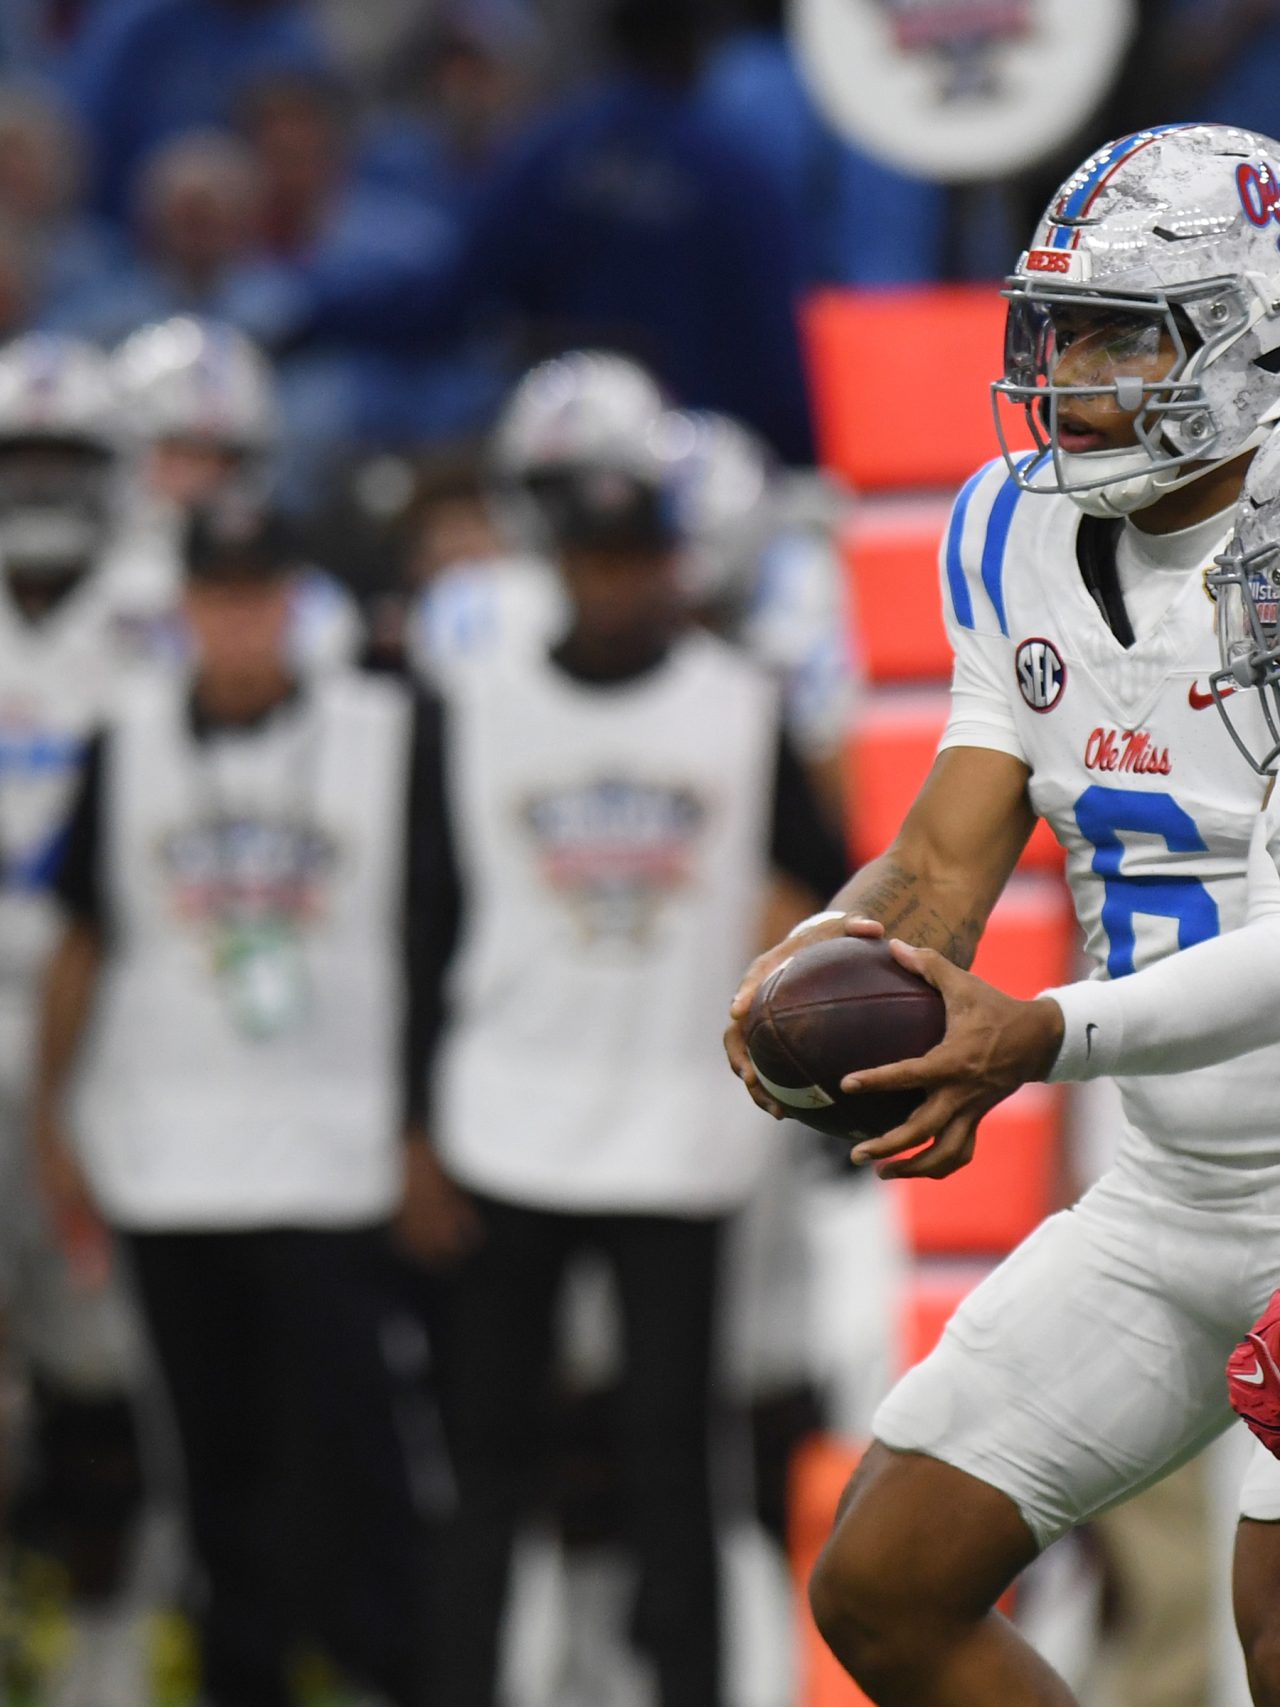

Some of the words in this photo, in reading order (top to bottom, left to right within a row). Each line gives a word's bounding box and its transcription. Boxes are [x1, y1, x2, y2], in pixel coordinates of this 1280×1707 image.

[1018, 642, 1061, 706] SEC
[1085, 727, 1118, 772] Ole
[1118, 729, 1172, 776] Miss
[1073, 784, 1221, 981] 6
